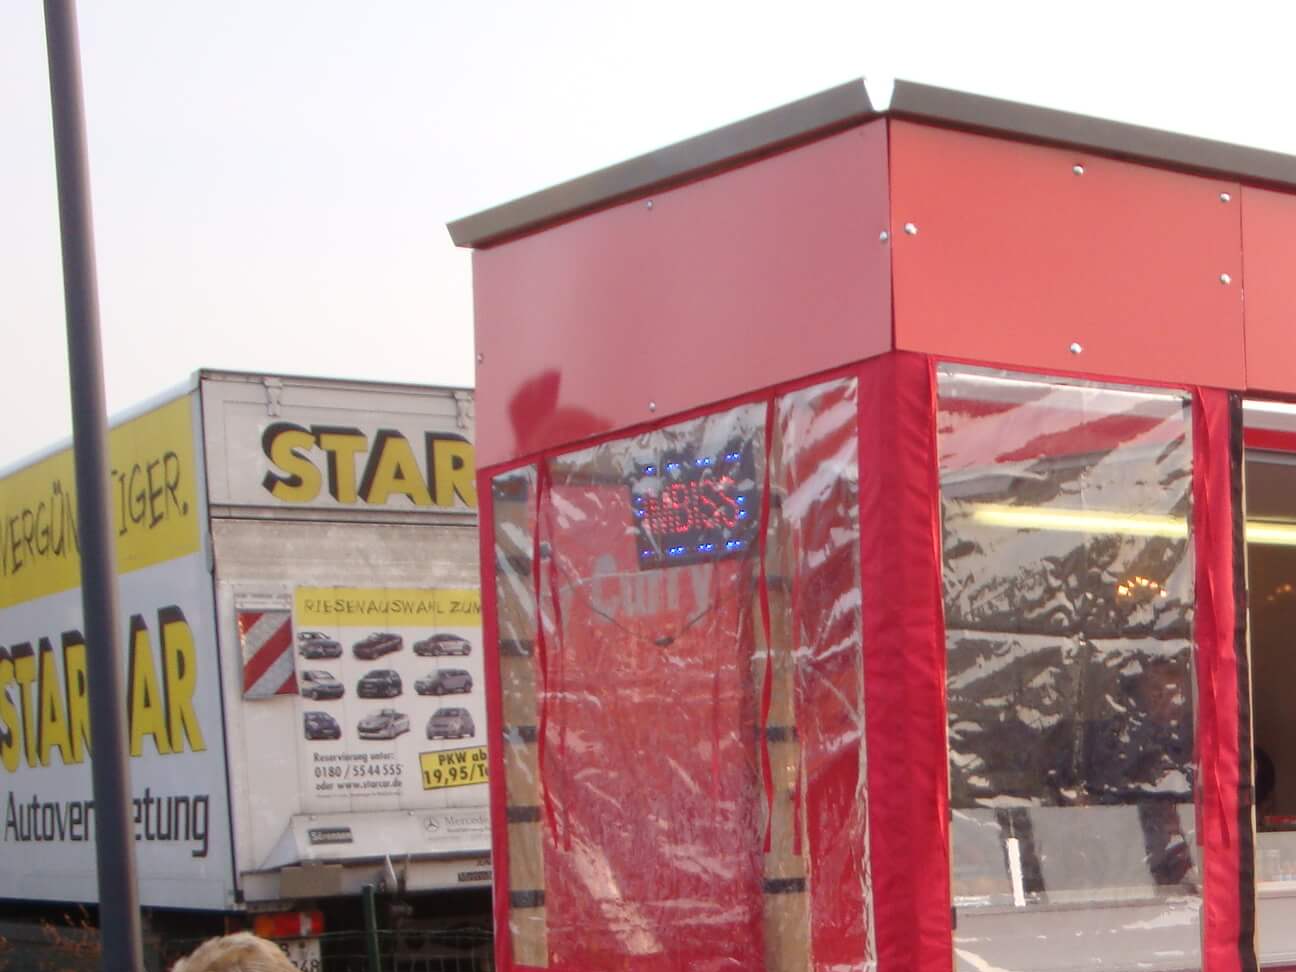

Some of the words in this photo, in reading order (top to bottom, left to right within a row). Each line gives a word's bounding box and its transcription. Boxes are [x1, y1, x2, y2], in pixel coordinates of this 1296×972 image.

[0, 604, 206, 773] STARAR
[438, 750, 466, 766] PKW
[472, 748, 487, 762] ab
[314, 766, 342, 778] 0180
